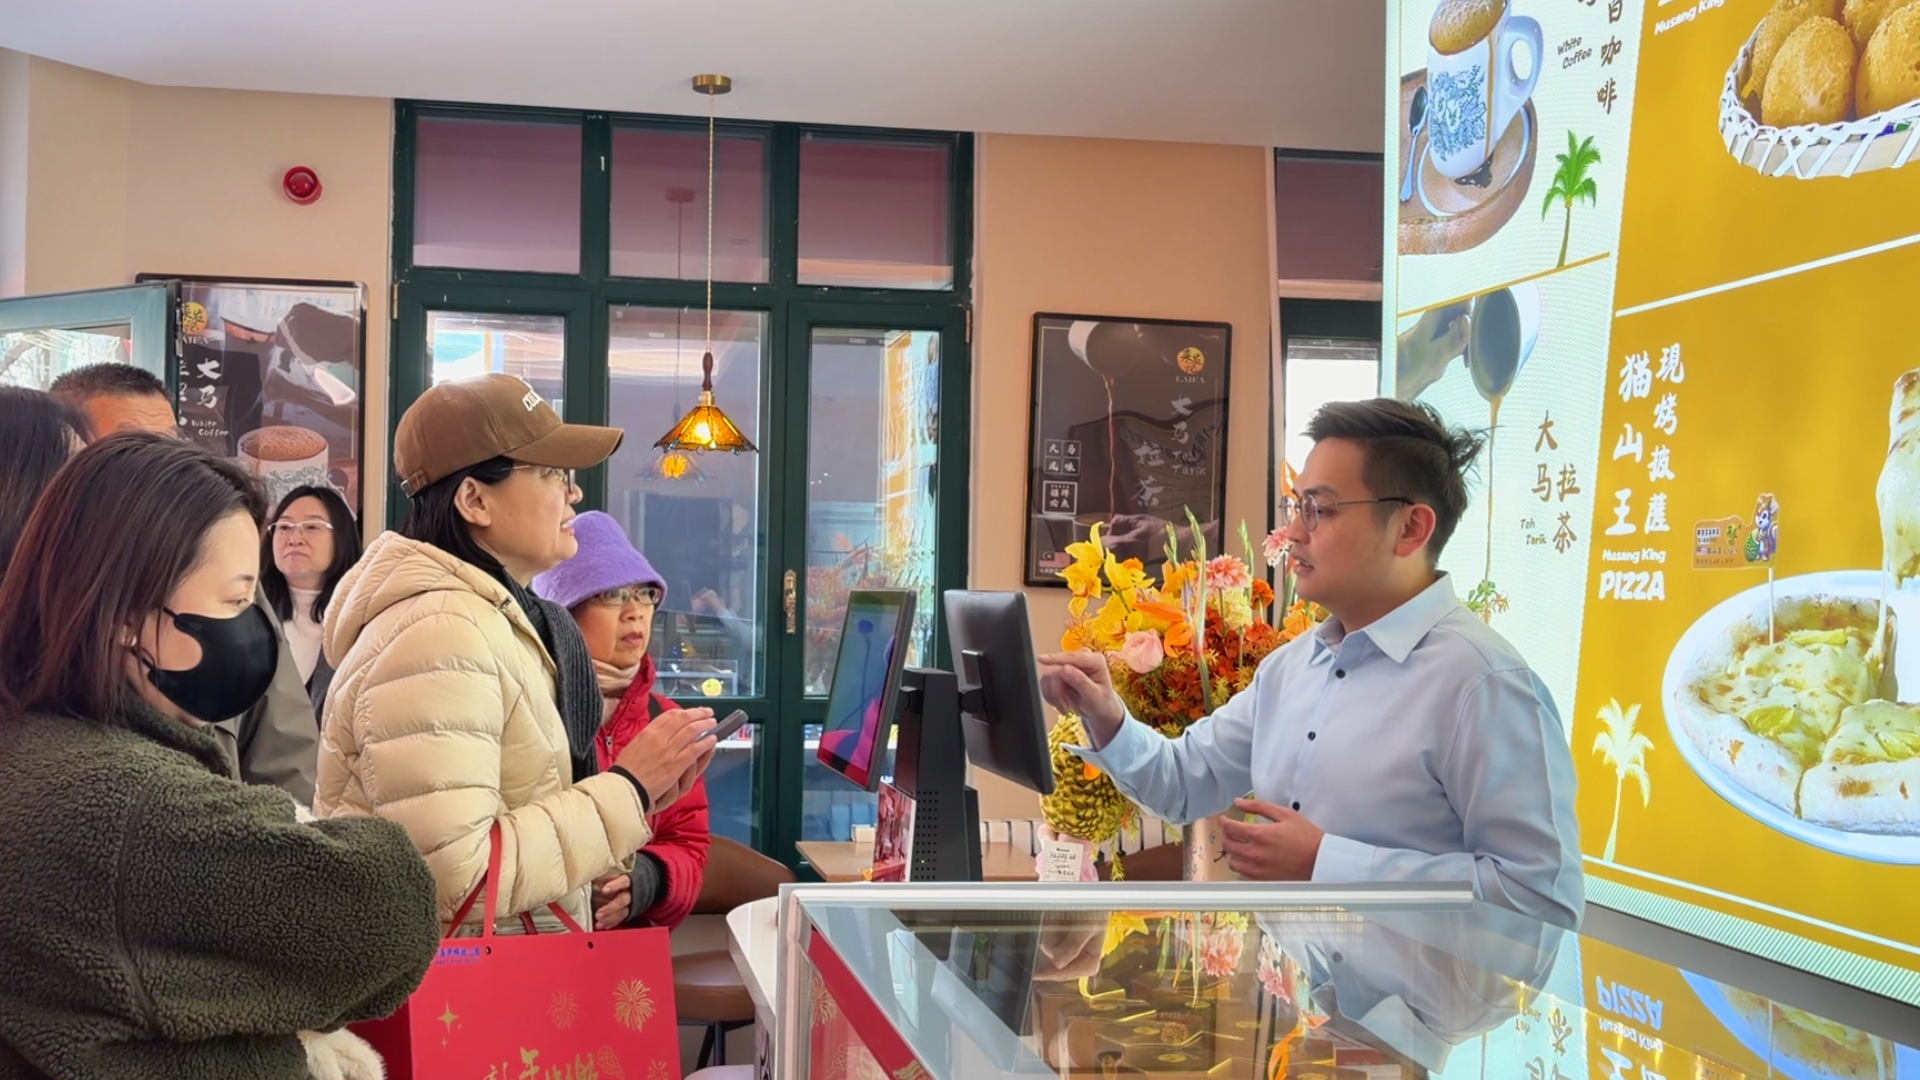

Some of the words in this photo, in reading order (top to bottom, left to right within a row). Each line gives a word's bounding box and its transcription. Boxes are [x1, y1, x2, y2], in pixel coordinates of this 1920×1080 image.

[1557, 36, 1582, 56] White
[1562, 48, 1593, 70] Coffee
[196, 358, 221, 409] 大马
[1531, 410, 1558, 502] 大马
[1552, 463, 1581, 554] 拉茶
[1602, 549, 1640, 564] Musang
[1641, 547, 1666, 564] King
[1599, 570, 1665, 601] PIZZA
